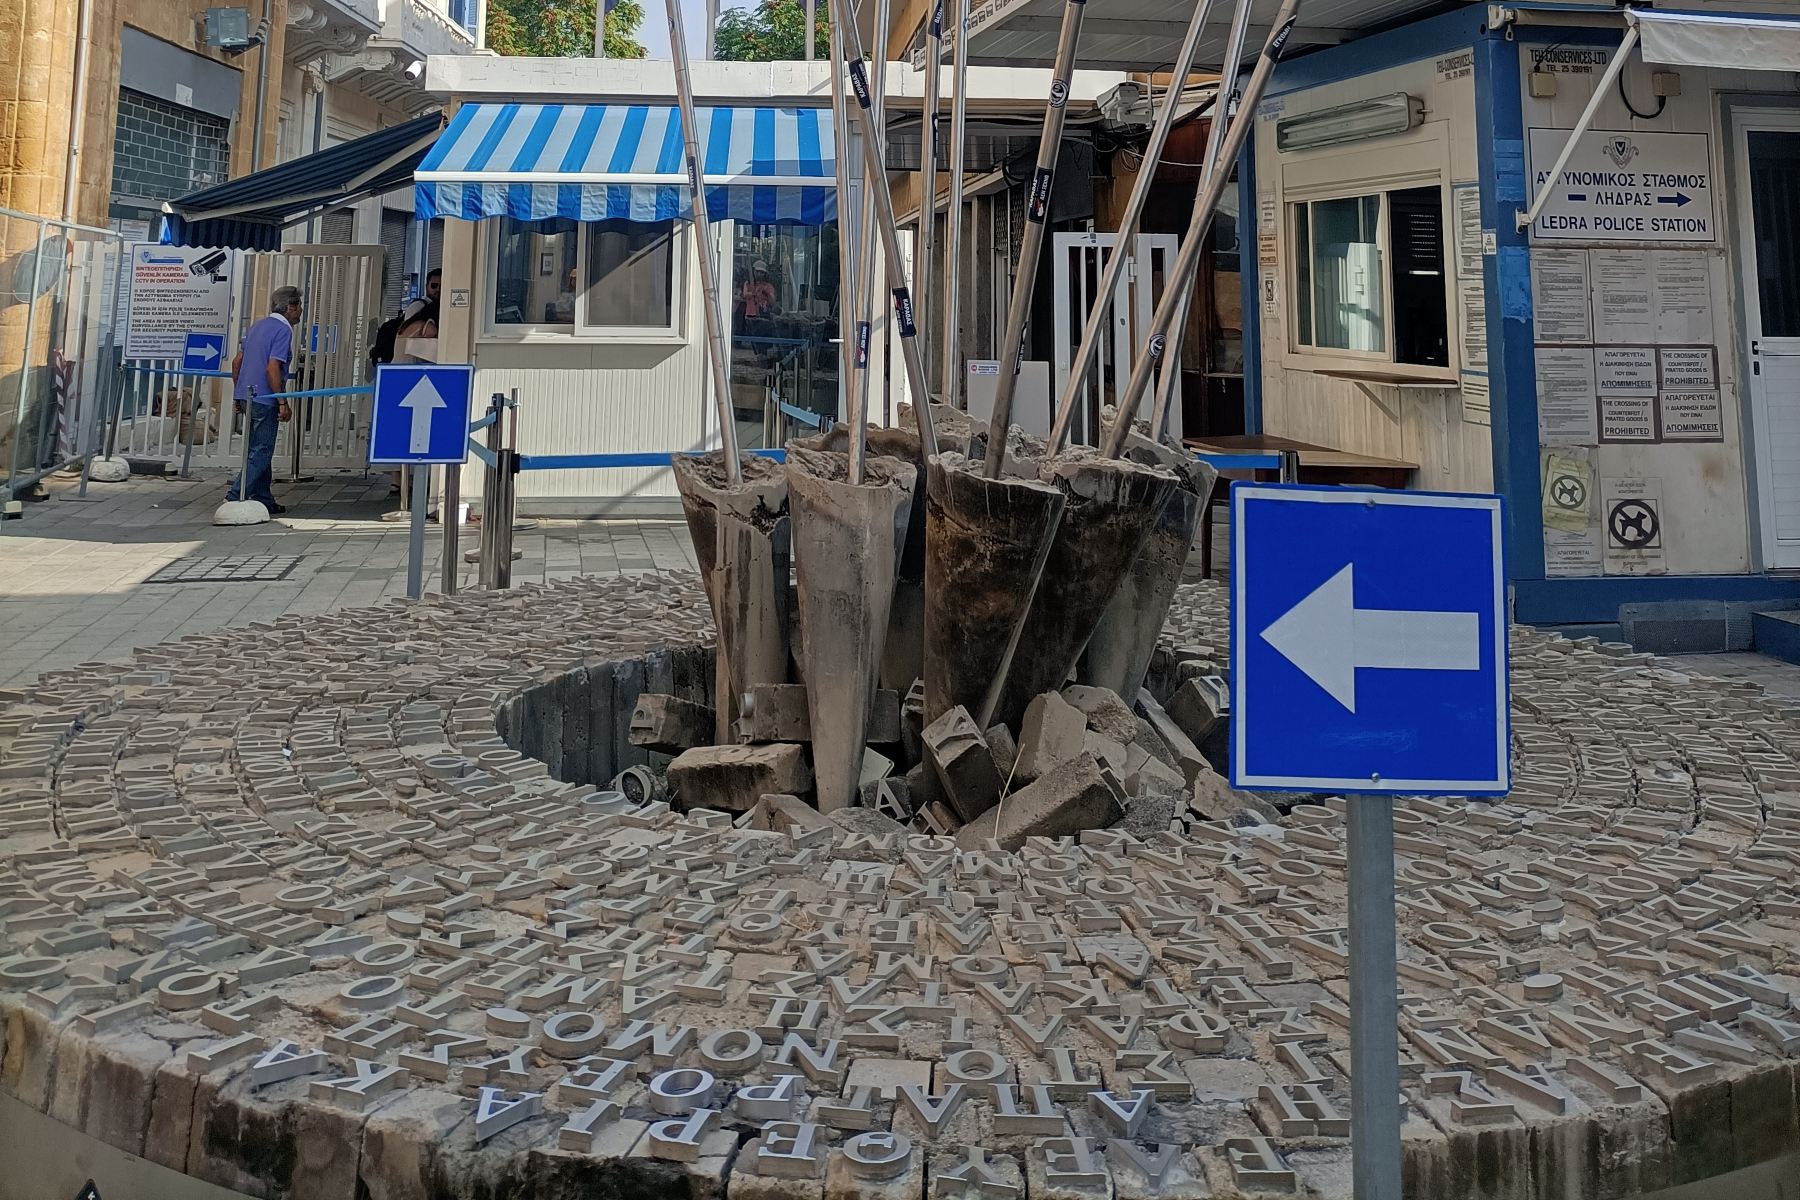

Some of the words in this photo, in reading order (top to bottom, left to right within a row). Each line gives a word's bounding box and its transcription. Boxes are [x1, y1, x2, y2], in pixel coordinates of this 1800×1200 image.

[851, 72, 866, 98] ΚΑΡΑΒΑΣ
[1536, 171, 1636, 187] ΑΣΥΝΟΜΙΚΟΣ
[1643, 173, 1707, 189] ΣΤΑΘΜΟΣ
[1595, 191, 1652, 206] ΛΗΔΡΑΣ
[1541, 216, 1588, 230] LEDRA
[1594, 217, 1644, 231] POLICE
[1651, 218, 1707, 233] STATION
[902, 298, 913, 326] ΚΑΡΑΒΑΣ
[1664, 377, 1709, 385] PROHIBITED
[1605, 427, 1650, 435] PROHIBITED
[1665, 423, 1719, 431] ΑΠΟΜΙΜΗΣΕΙΣ
